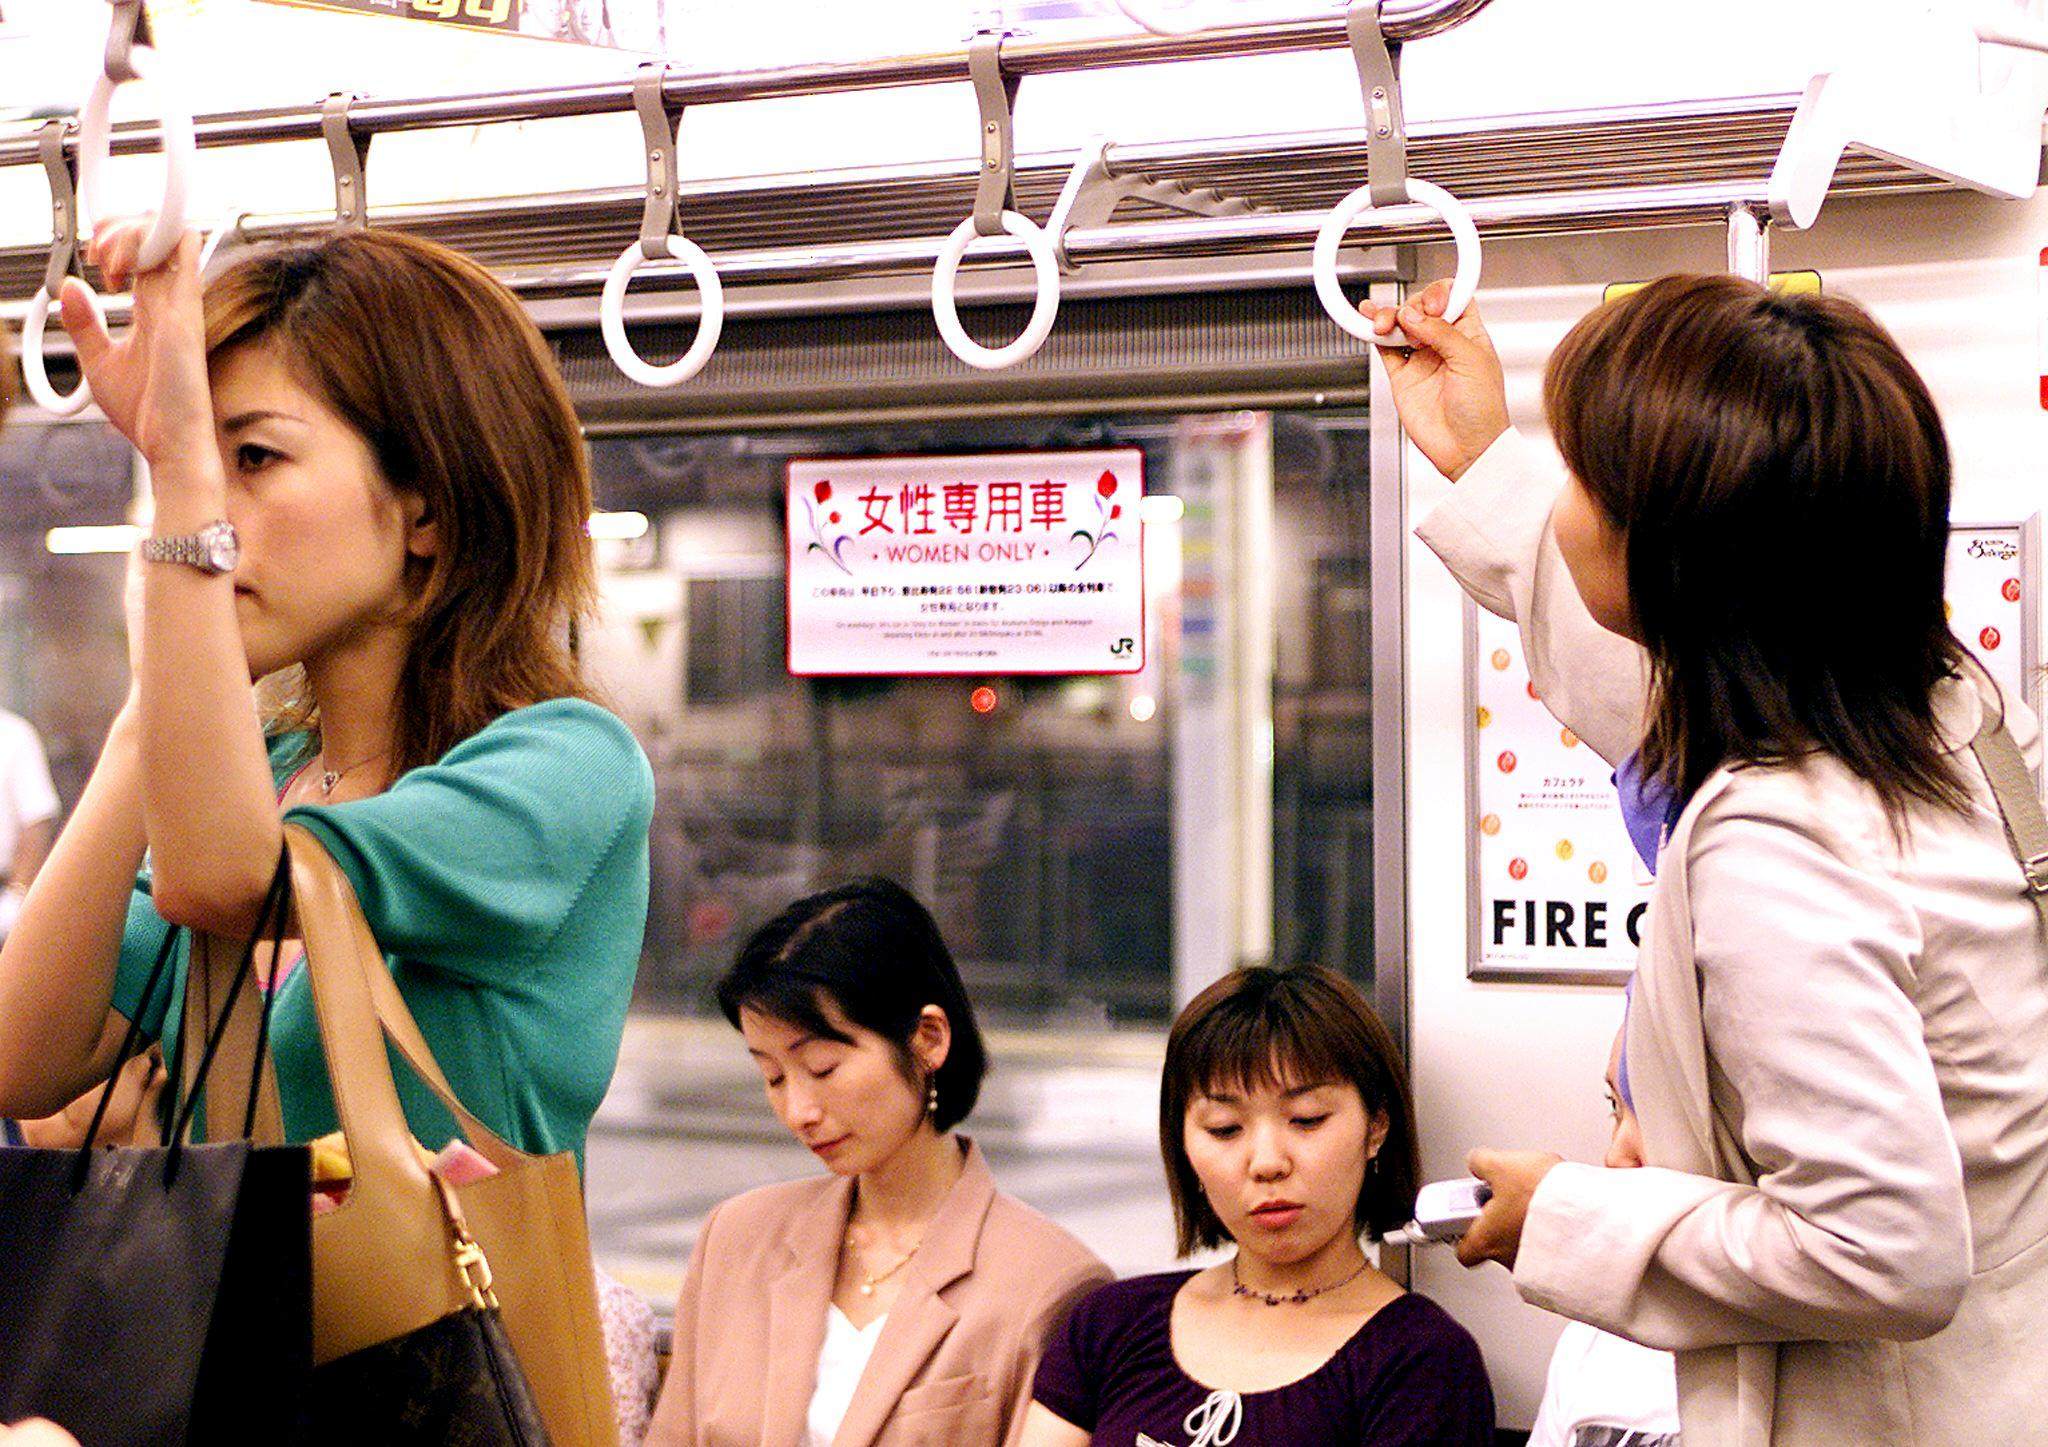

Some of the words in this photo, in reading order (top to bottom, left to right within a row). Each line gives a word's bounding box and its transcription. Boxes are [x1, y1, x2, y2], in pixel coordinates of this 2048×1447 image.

[857, 480, 1067, 537] 女性専用車
[886, 544, 969, 564] WOMEN
[978, 542, 1036, 562] ONLY
[1110, 638, 1134, 654] JR
[1493, 900, 1607, 948] FIRE
